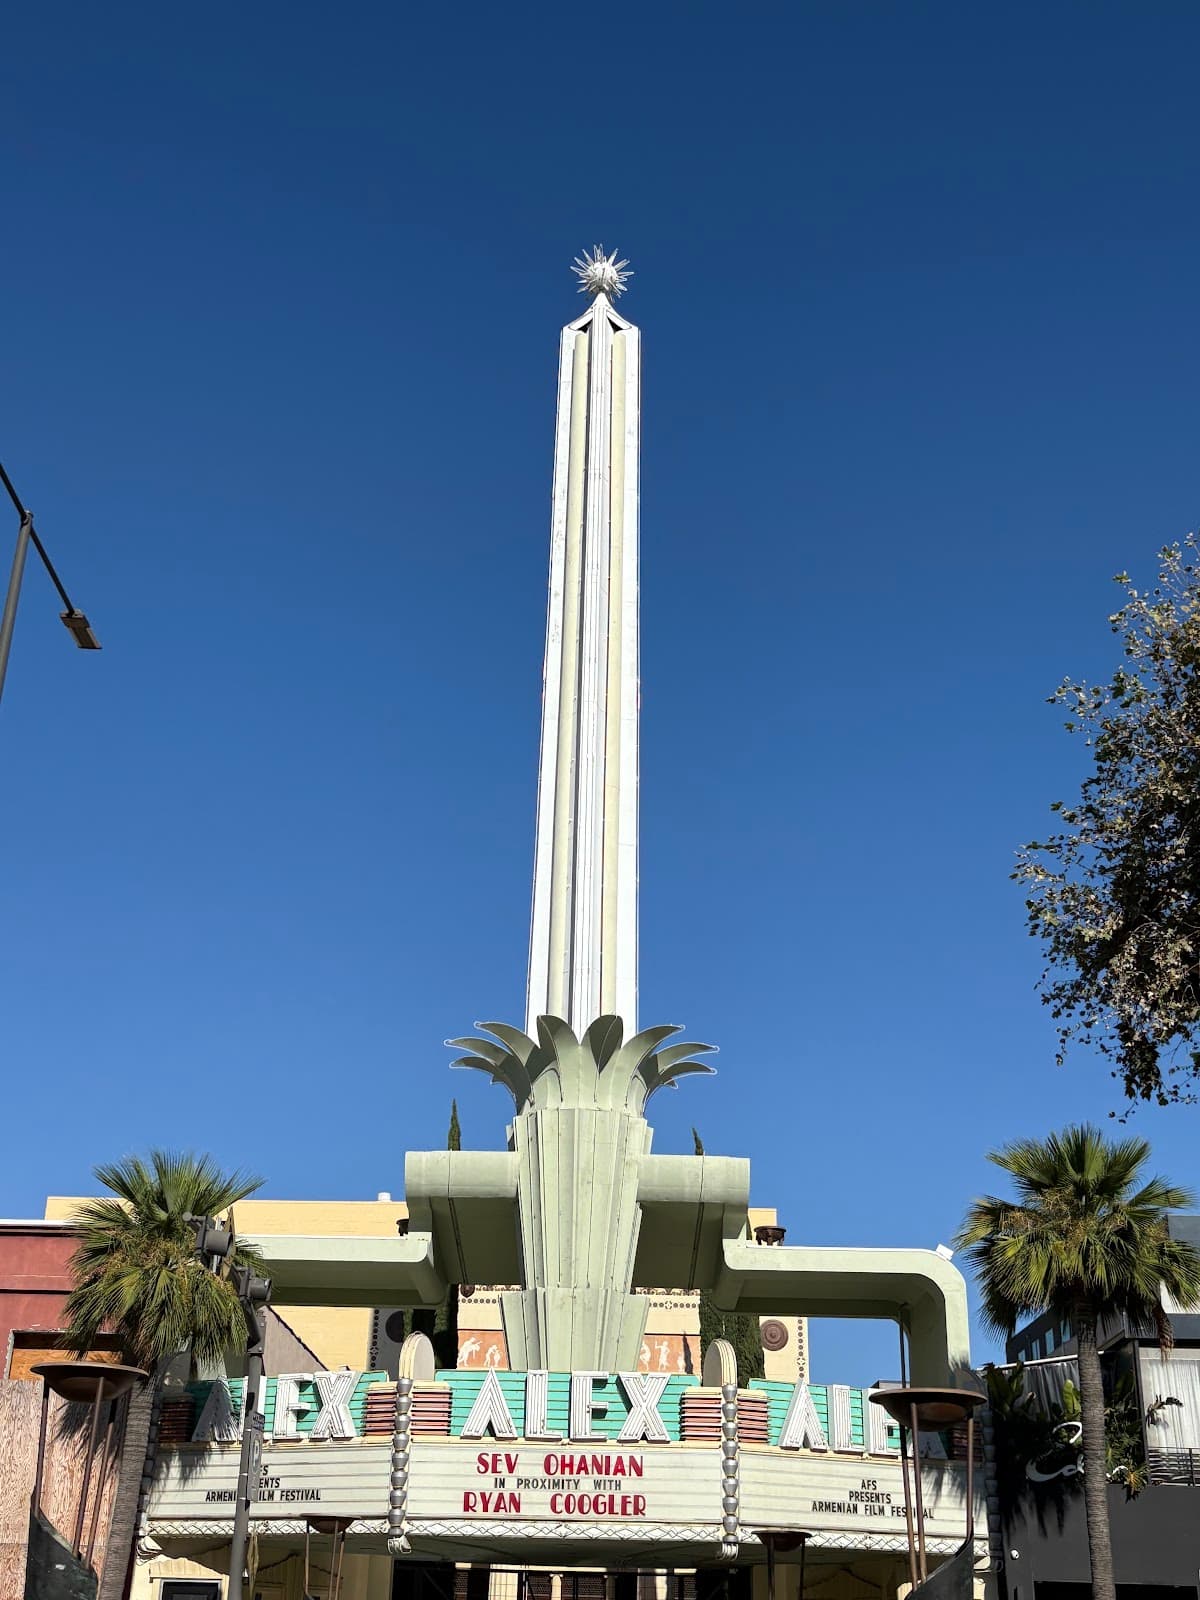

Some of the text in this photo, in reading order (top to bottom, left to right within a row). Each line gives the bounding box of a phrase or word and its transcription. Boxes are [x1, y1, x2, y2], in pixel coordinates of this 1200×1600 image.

[460, 1367, 671, 1444] ALEX
[476, 1452, 644, 1477] SEV OHANIAN
[494, 1477, 622, 1491] IN PROXIMITY WITH
[861, 1479, 877, 1491] AFS
[205, 1489, 321, 1502] ARMENI ILM FESTIVAL
[849, 1490, 892, 1504] PRESENTS
[463, 1492, 647, 1516] RYAN COOGLER
[811, 1501, 935, 1519] ARMENIAN FILM FESIAL
